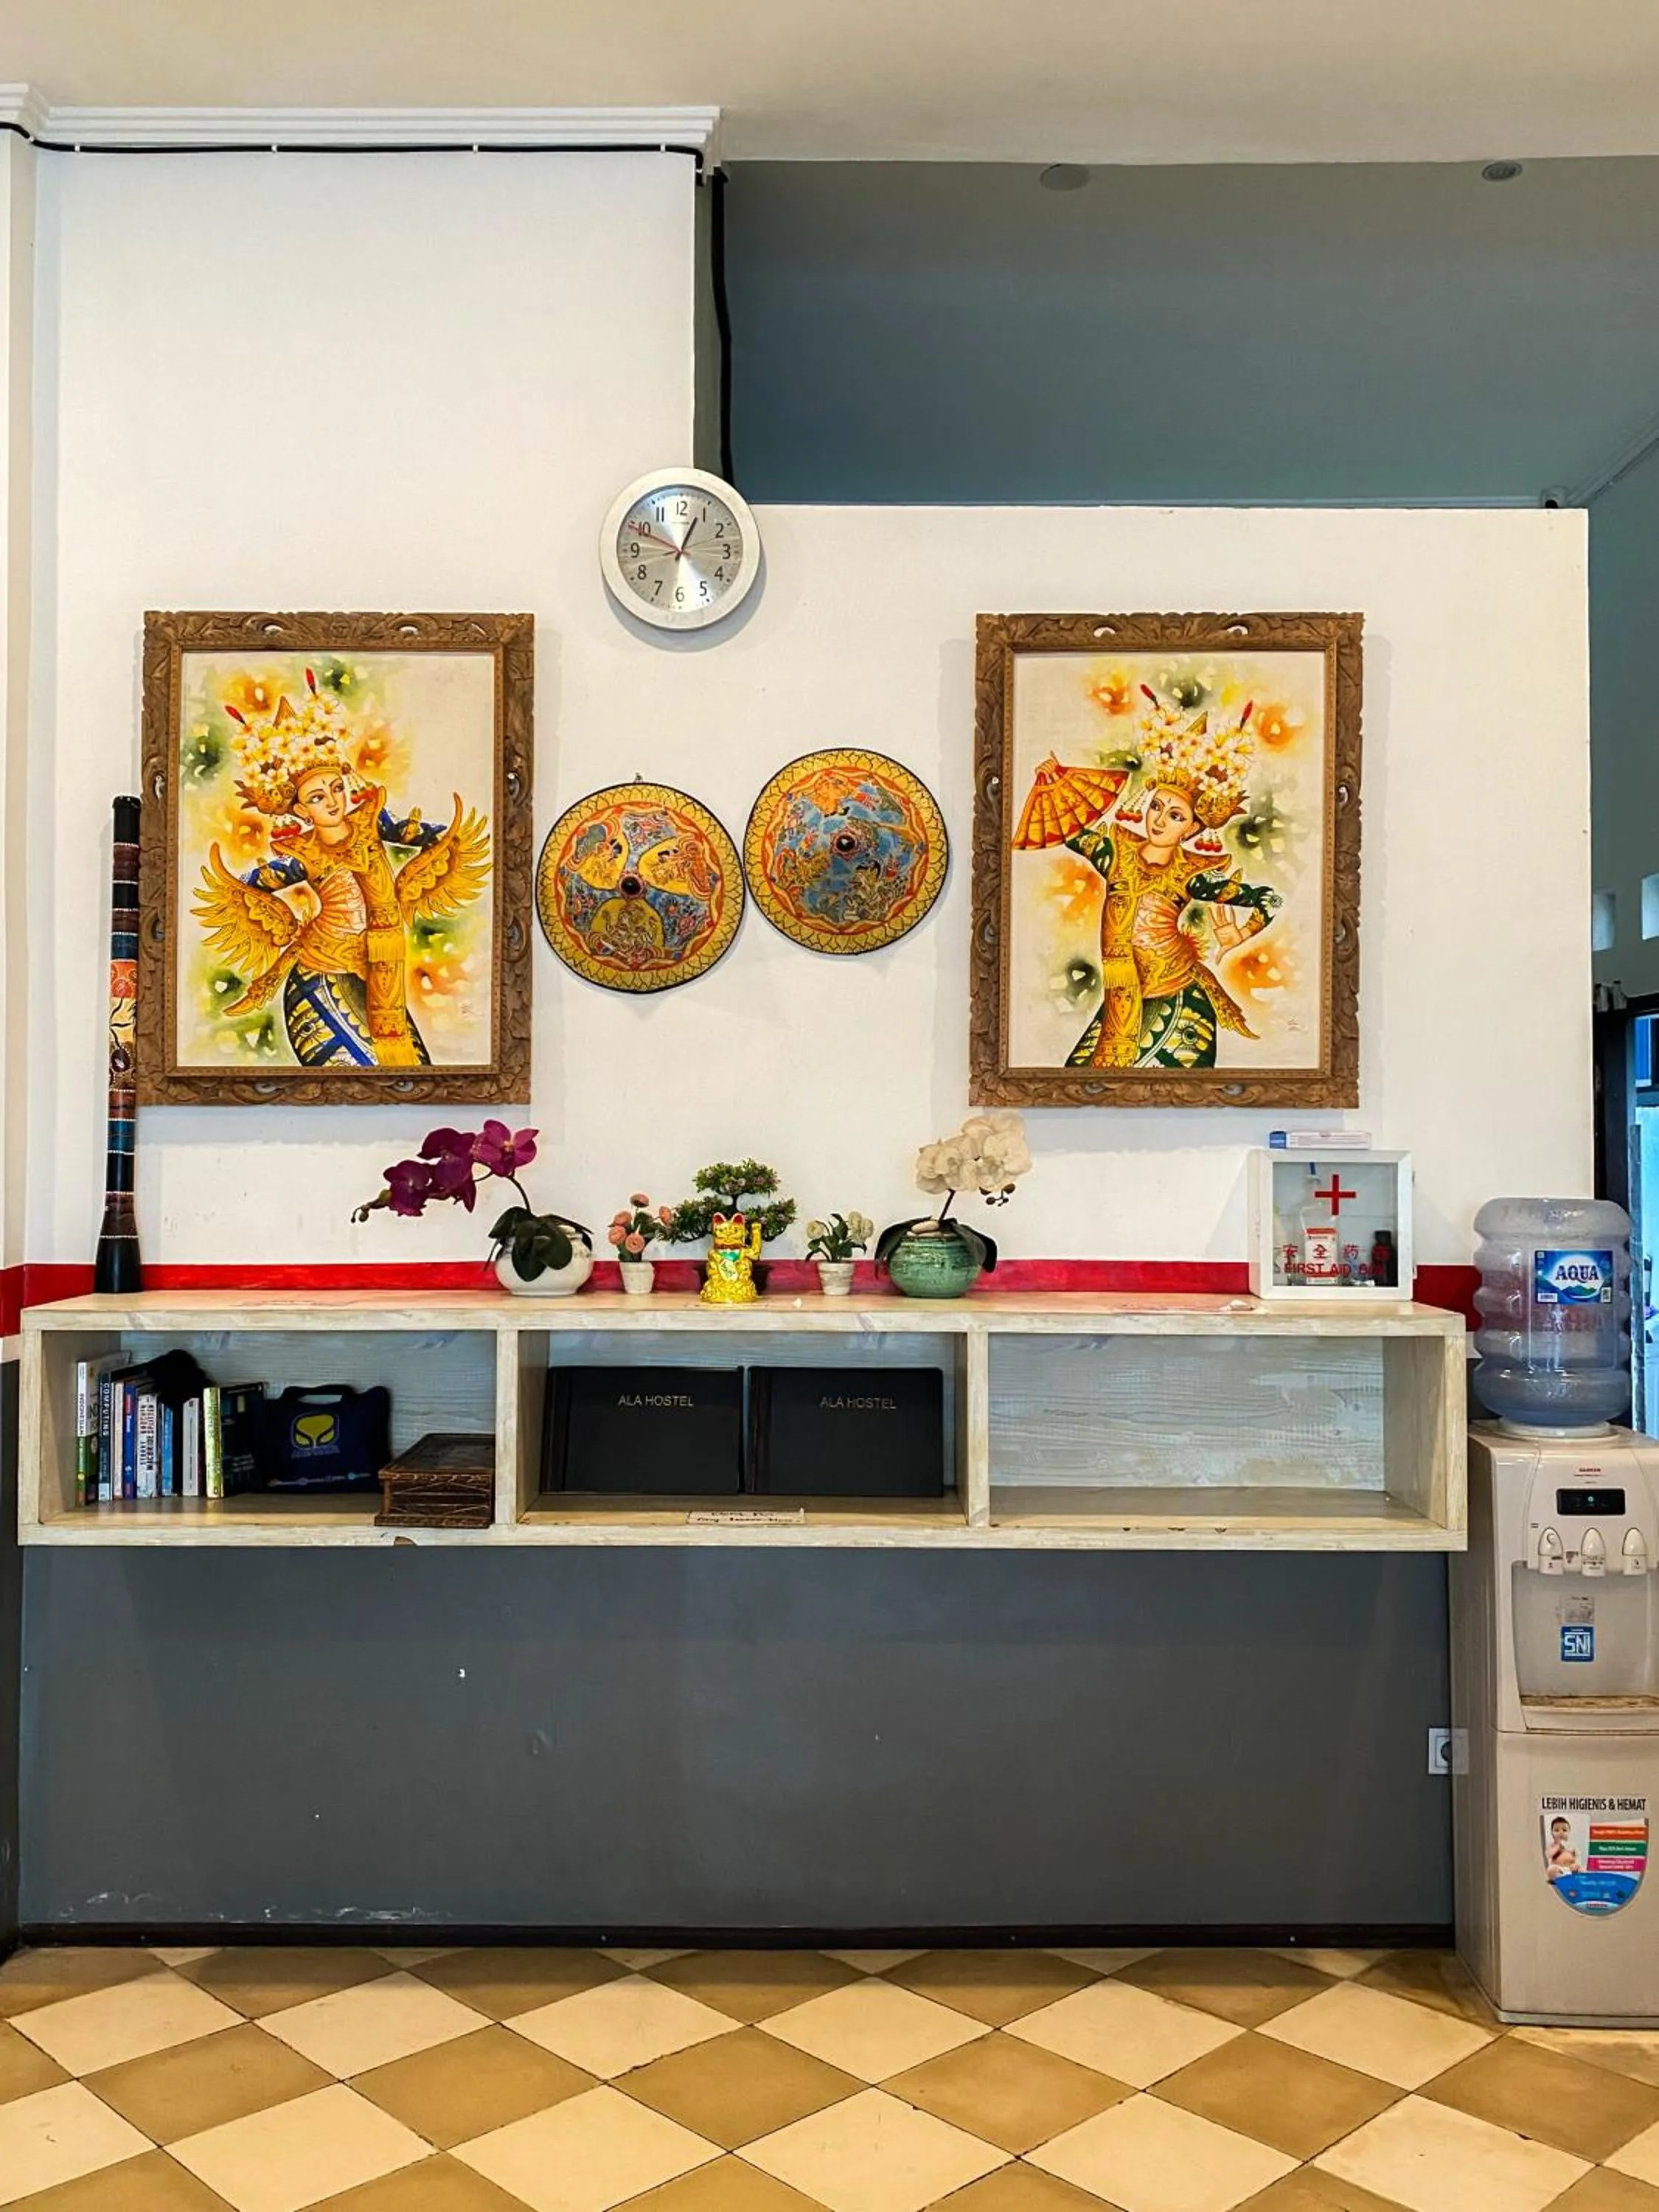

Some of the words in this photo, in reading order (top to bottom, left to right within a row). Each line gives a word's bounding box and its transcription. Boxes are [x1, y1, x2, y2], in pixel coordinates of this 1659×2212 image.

[656, 507, 664, 522] 11
[675, 501, 688, 515] 12
[638, 521, 650, 537] 10
[715, 523, 724, 538] 2
[630, 543, 640, 558] 9
[722, 544, 731, 560] 3
[637, 565, 647, 580] 8
[714, 566, 723, 581] 4
[654, 580, 662, 596] 7
[675, 587, 684, 602] 6
[699, 581, 707, 596] 5
[1284, 1263, 1325, 1274] FIRST
[1330, 1264, 1352, 1275] AID
[1555, 1265, 1599, 1283] AQUA
[618, 1394, 641, 1406] ALA
[645, 1395, 694, 1407] HOSTEL
[820, 1397, 844, 1408] ALA
[847, 1397, 897, 1409] HOSTEL
[1564, 1634, 1590, 1655] SNI
[1542, 1797, 1567, 1809] LEBIH
[1569, 1798, 1607, 1810] HIGIENIS
[1608, 1798, 1615, 1810] &
[1617, 1798, 1646, 1810] HEMAT
